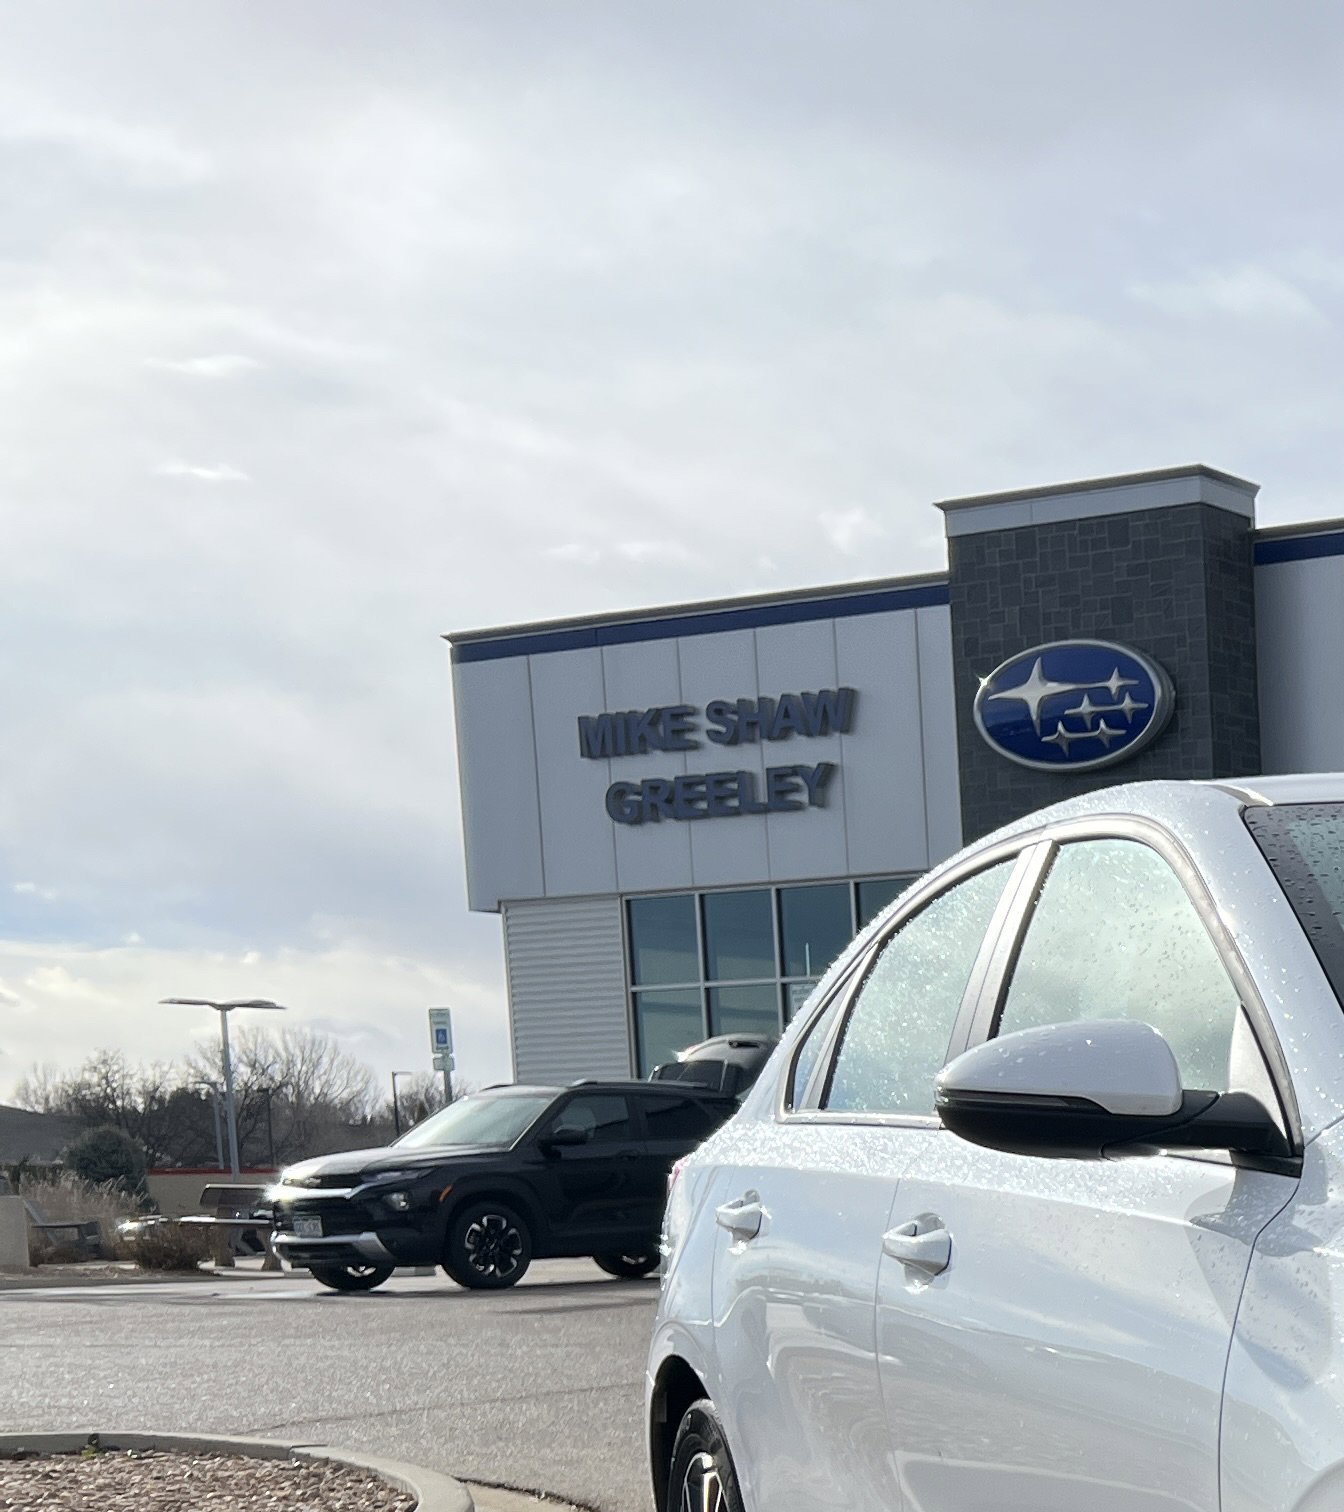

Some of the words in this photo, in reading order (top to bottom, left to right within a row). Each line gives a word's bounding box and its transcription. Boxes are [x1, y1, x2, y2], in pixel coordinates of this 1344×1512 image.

[577, 704, 700, 759] MIKE
[705, 686, 859, 746] SHAW
[605, 761, 838, 825] GREELEY
